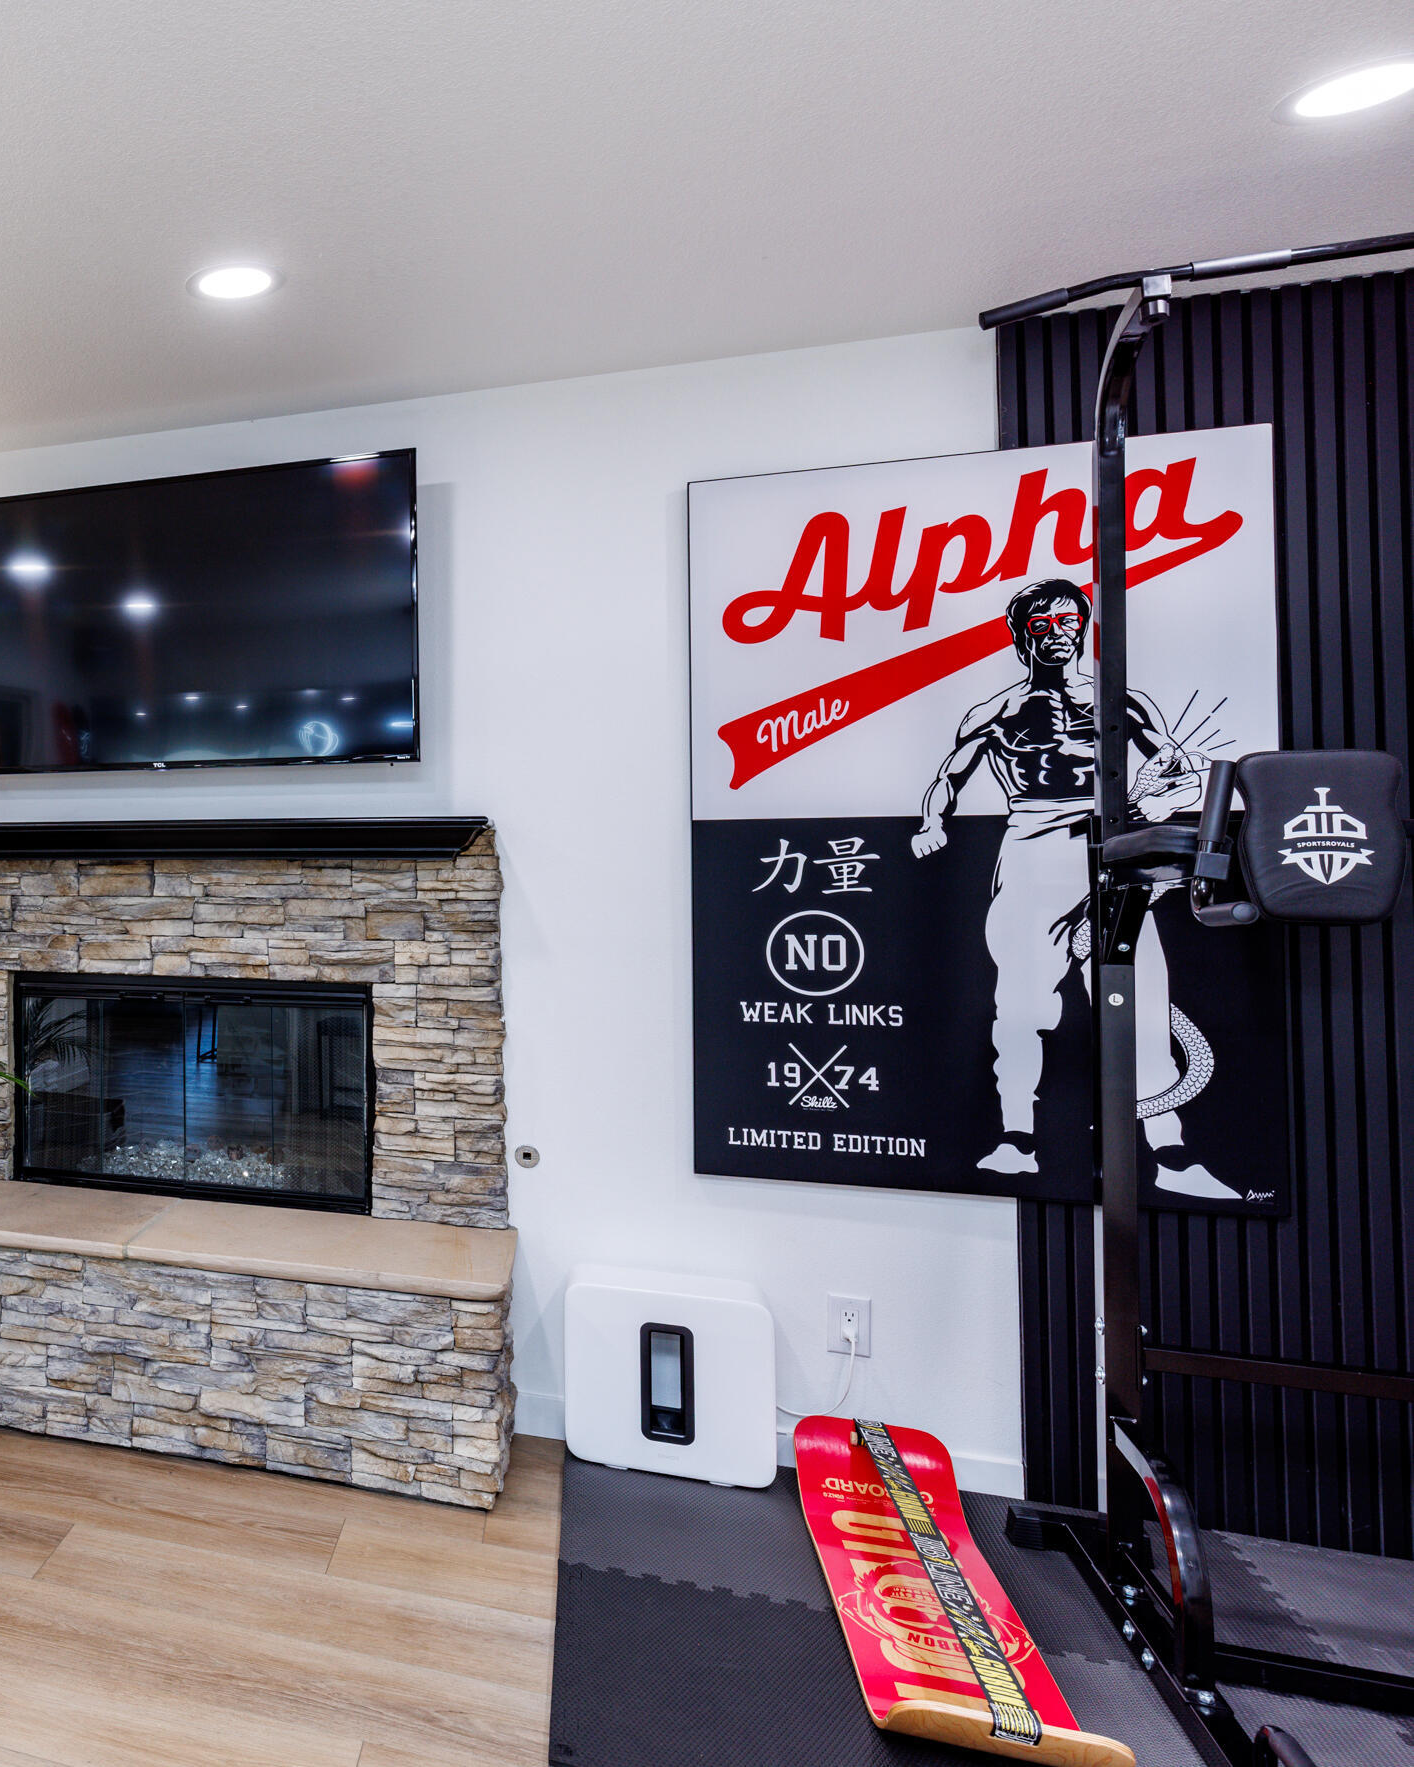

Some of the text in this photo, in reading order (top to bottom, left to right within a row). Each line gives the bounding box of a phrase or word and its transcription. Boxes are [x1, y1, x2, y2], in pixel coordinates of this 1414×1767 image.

[722, 457, 1243, 643] Alpha
[756, 697, 849, 753] Male
[1296, 840, 1356, 849] SPORTSROYALS
[751, 836, 881, 895] 力量
[784, 934, 847, 971] NO
[739, 1001, 904, 1027] WEAK LINKS
[800, 1095, 838, 1109] Skillz
[728, 1127, 927, 1157] LIMITED EDITION
[824, 1477, 934, 1505] GOARD
